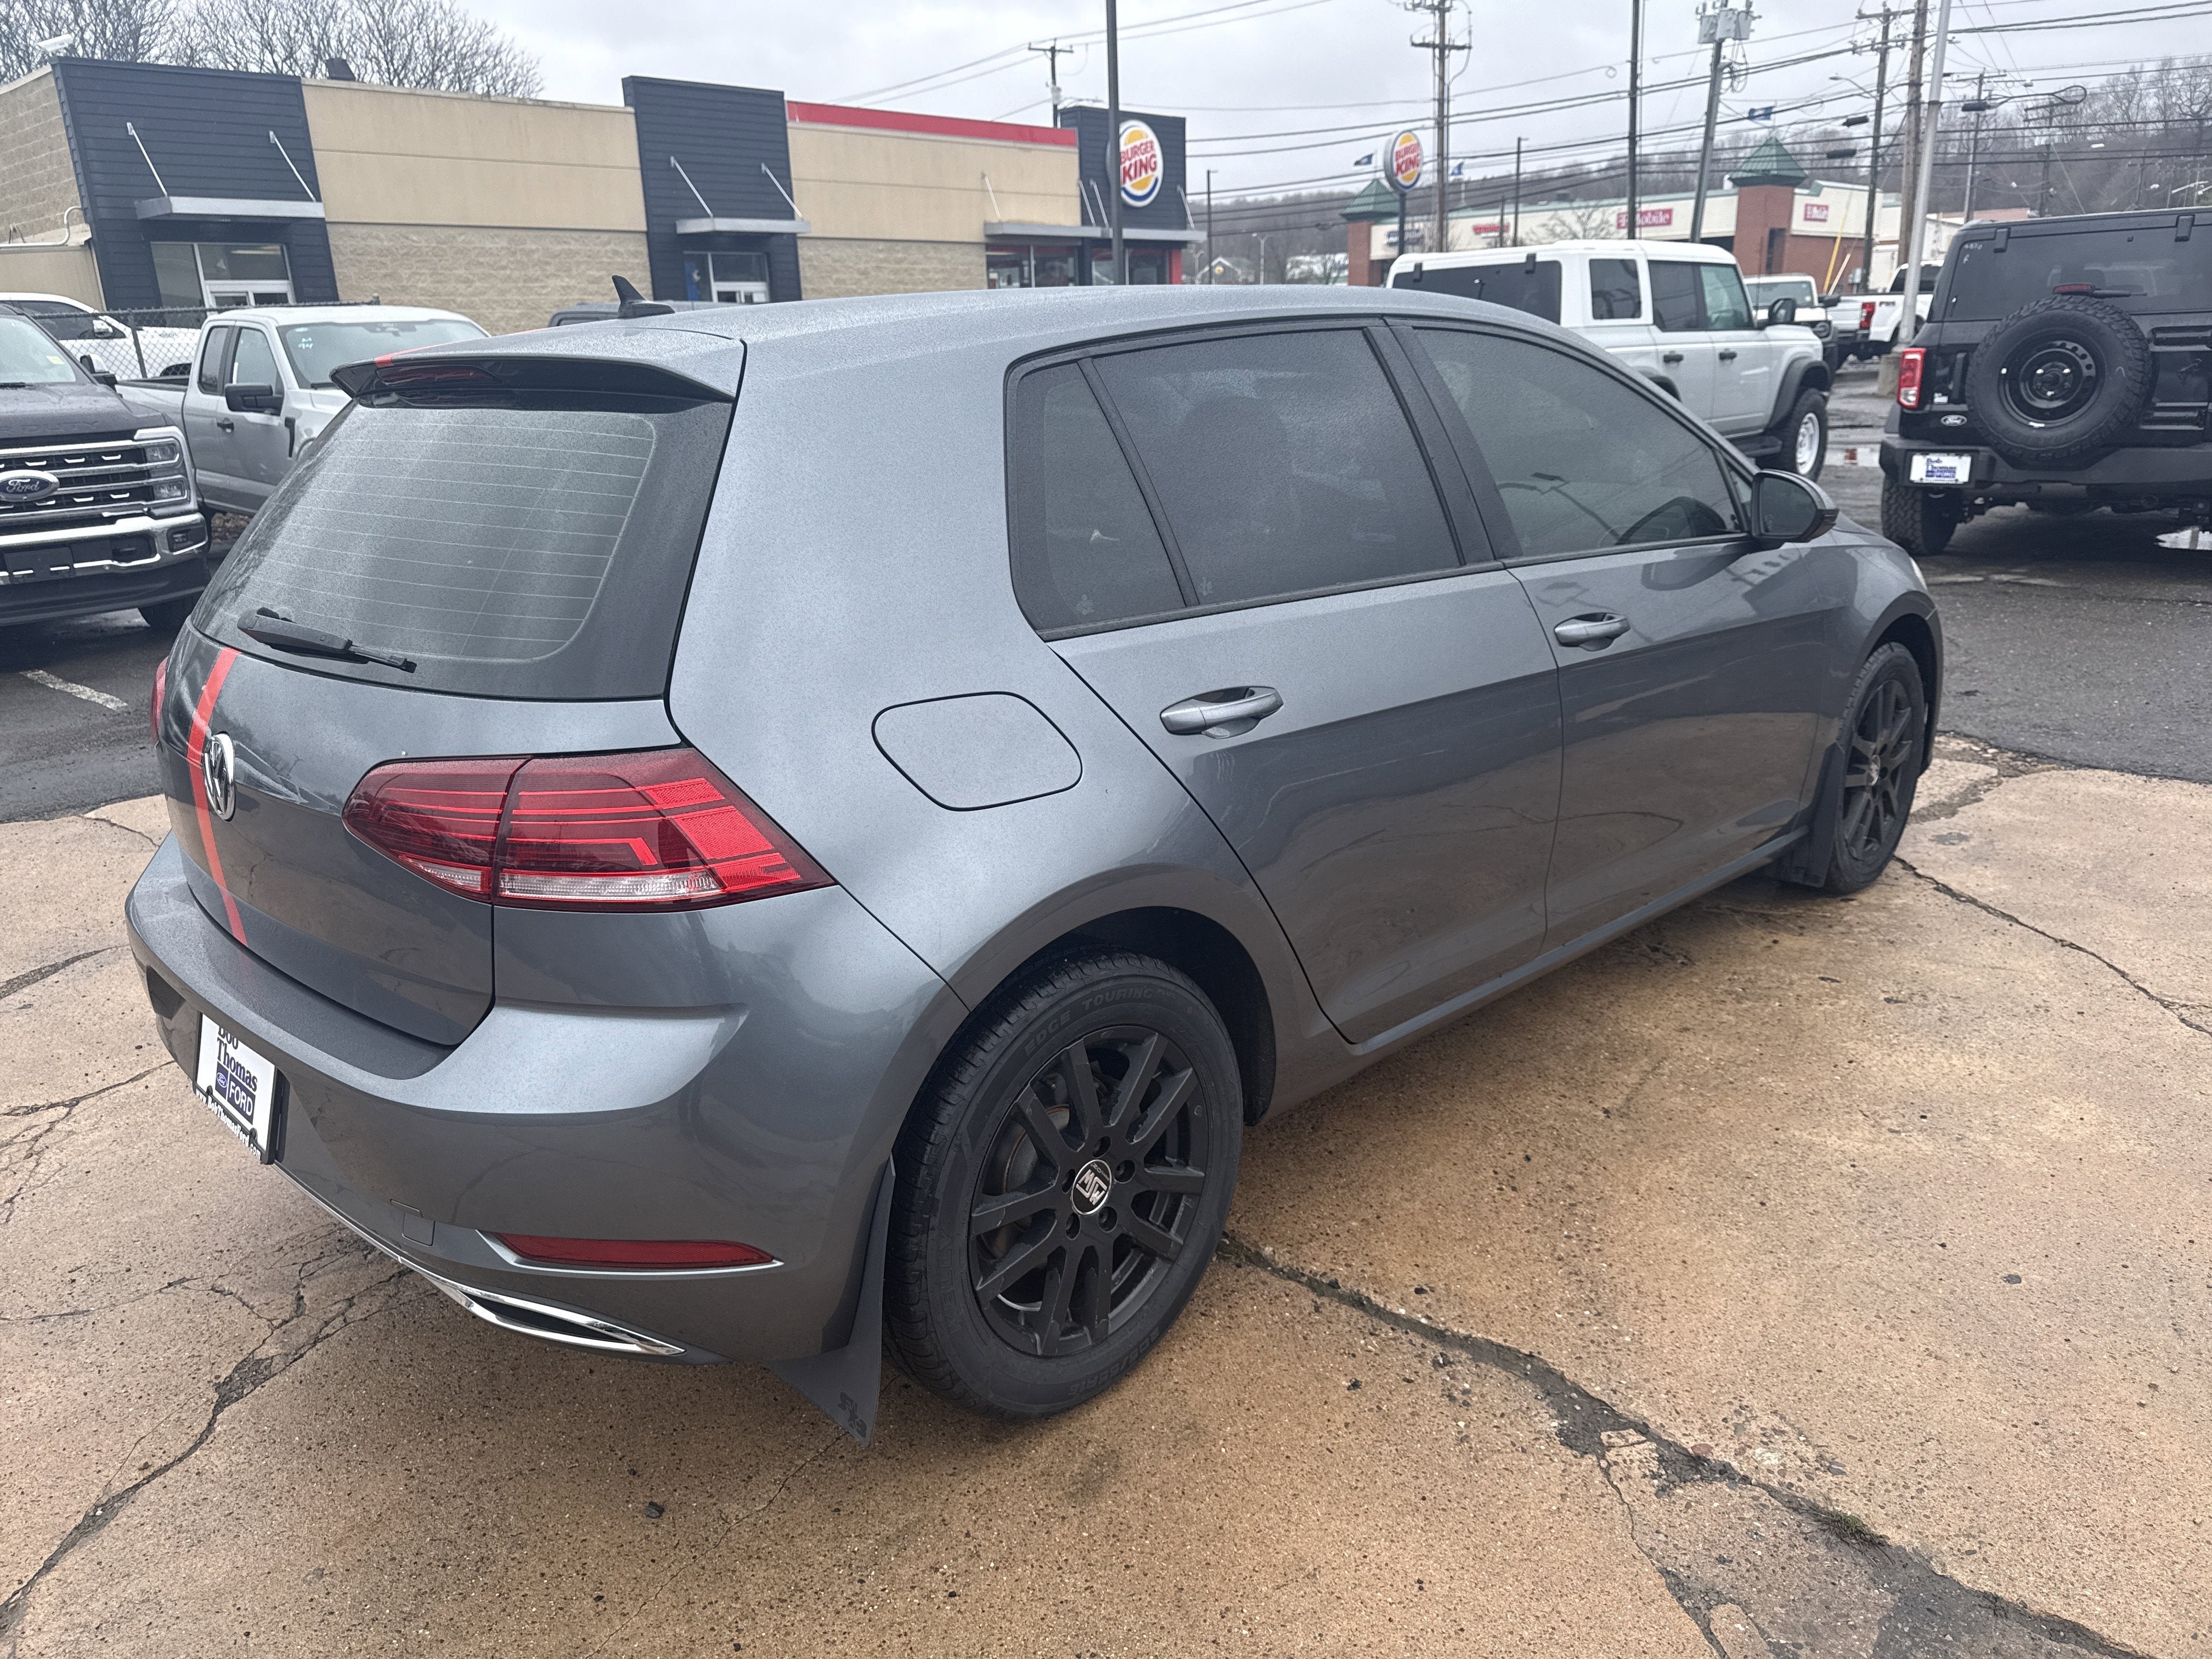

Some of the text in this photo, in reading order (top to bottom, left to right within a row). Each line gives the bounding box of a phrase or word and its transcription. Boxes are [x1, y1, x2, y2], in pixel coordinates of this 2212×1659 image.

[1120, 139, 1155, 165] BURGER
[1395, 153, 1420, 178] KING
[1121, 153, 1157, 187] KING
[6, 479, 40, 493] Ford
[1024, 987, 1176, 1056] EDGE TOURING PLUS
[217, 1037, 257, 1092] Thomas
[229, 1080, 253, 1116] FORD
[196, 1088, 261, 1161] www.BobThomasFord.com
